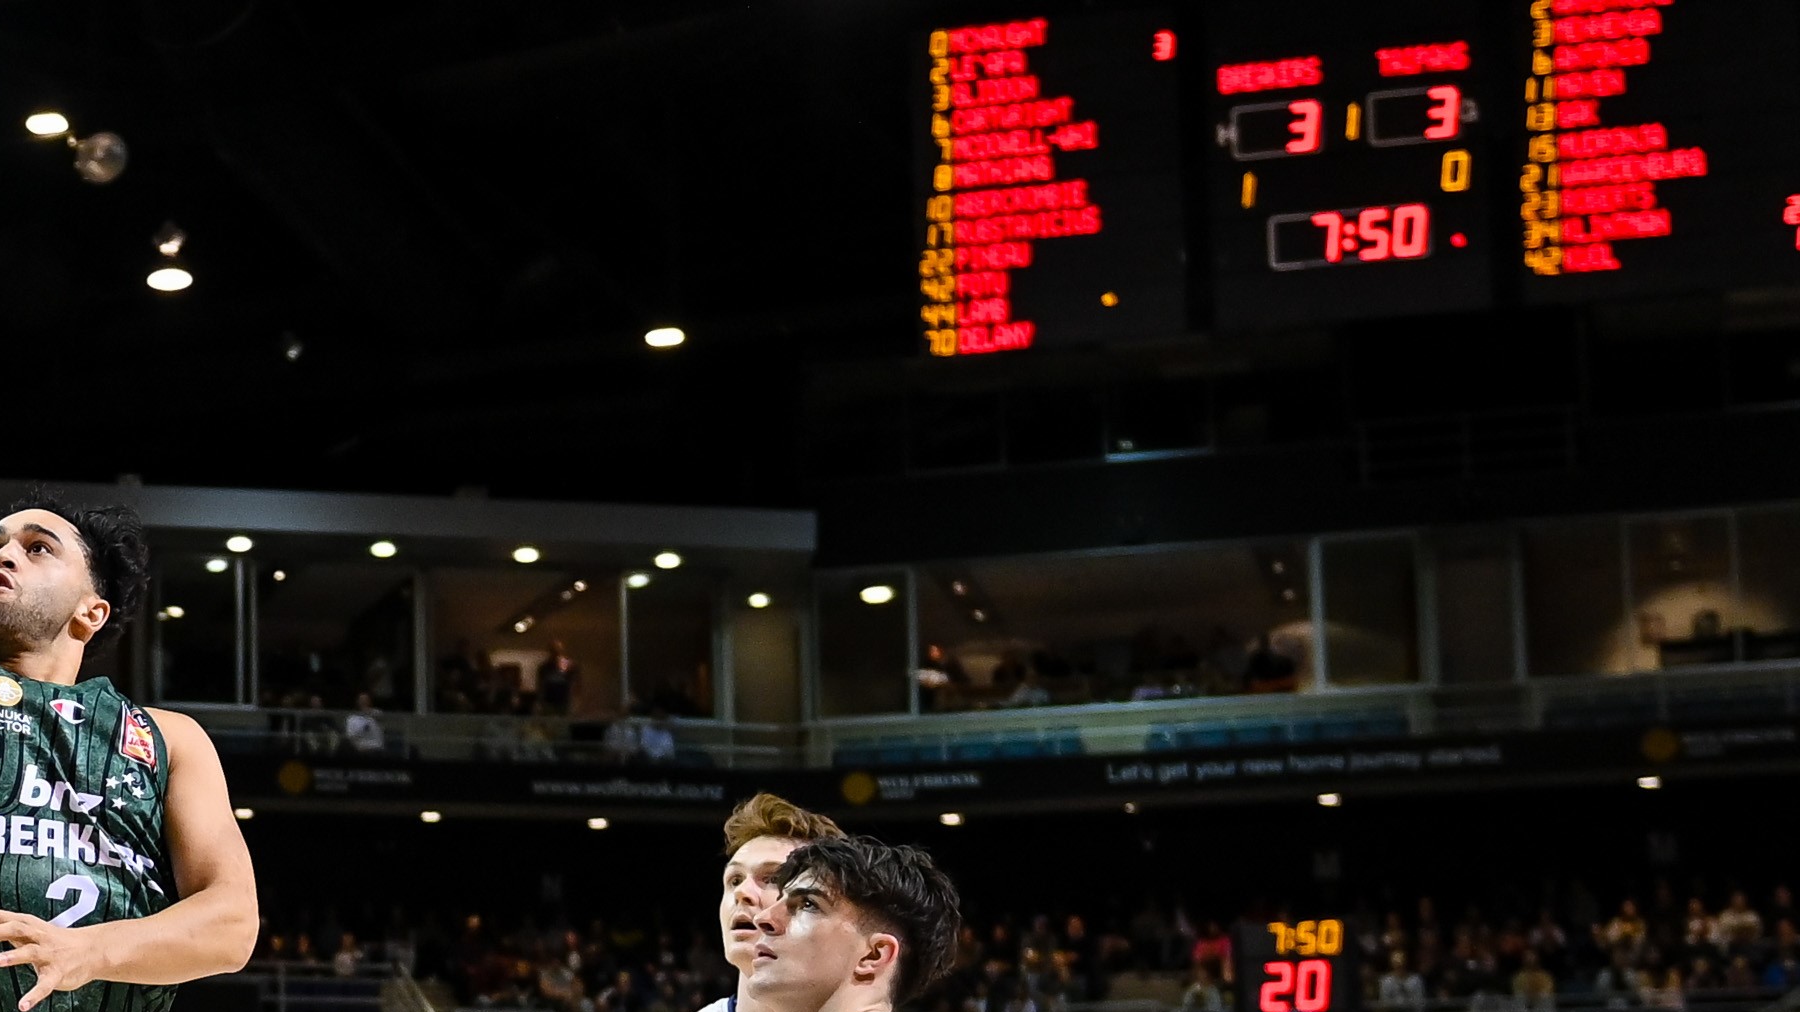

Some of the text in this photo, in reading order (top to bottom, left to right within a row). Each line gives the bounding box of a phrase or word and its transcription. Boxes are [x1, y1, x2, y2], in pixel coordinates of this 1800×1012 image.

[1153, 29, 1177, 61] 3
[1286, 98, 1322, 154] 3
[1345, 102, 1361, 140] 1
[1423, 85, 1460, 140] 3
[1241, 172, 1257, 209] 1
[1440, 149, 1471, 192] 0
[1311, 203, 1430, 263] 7:50
[46, 874, 99, 928] 2
[1267, 919, 1344, 956] 7:50
